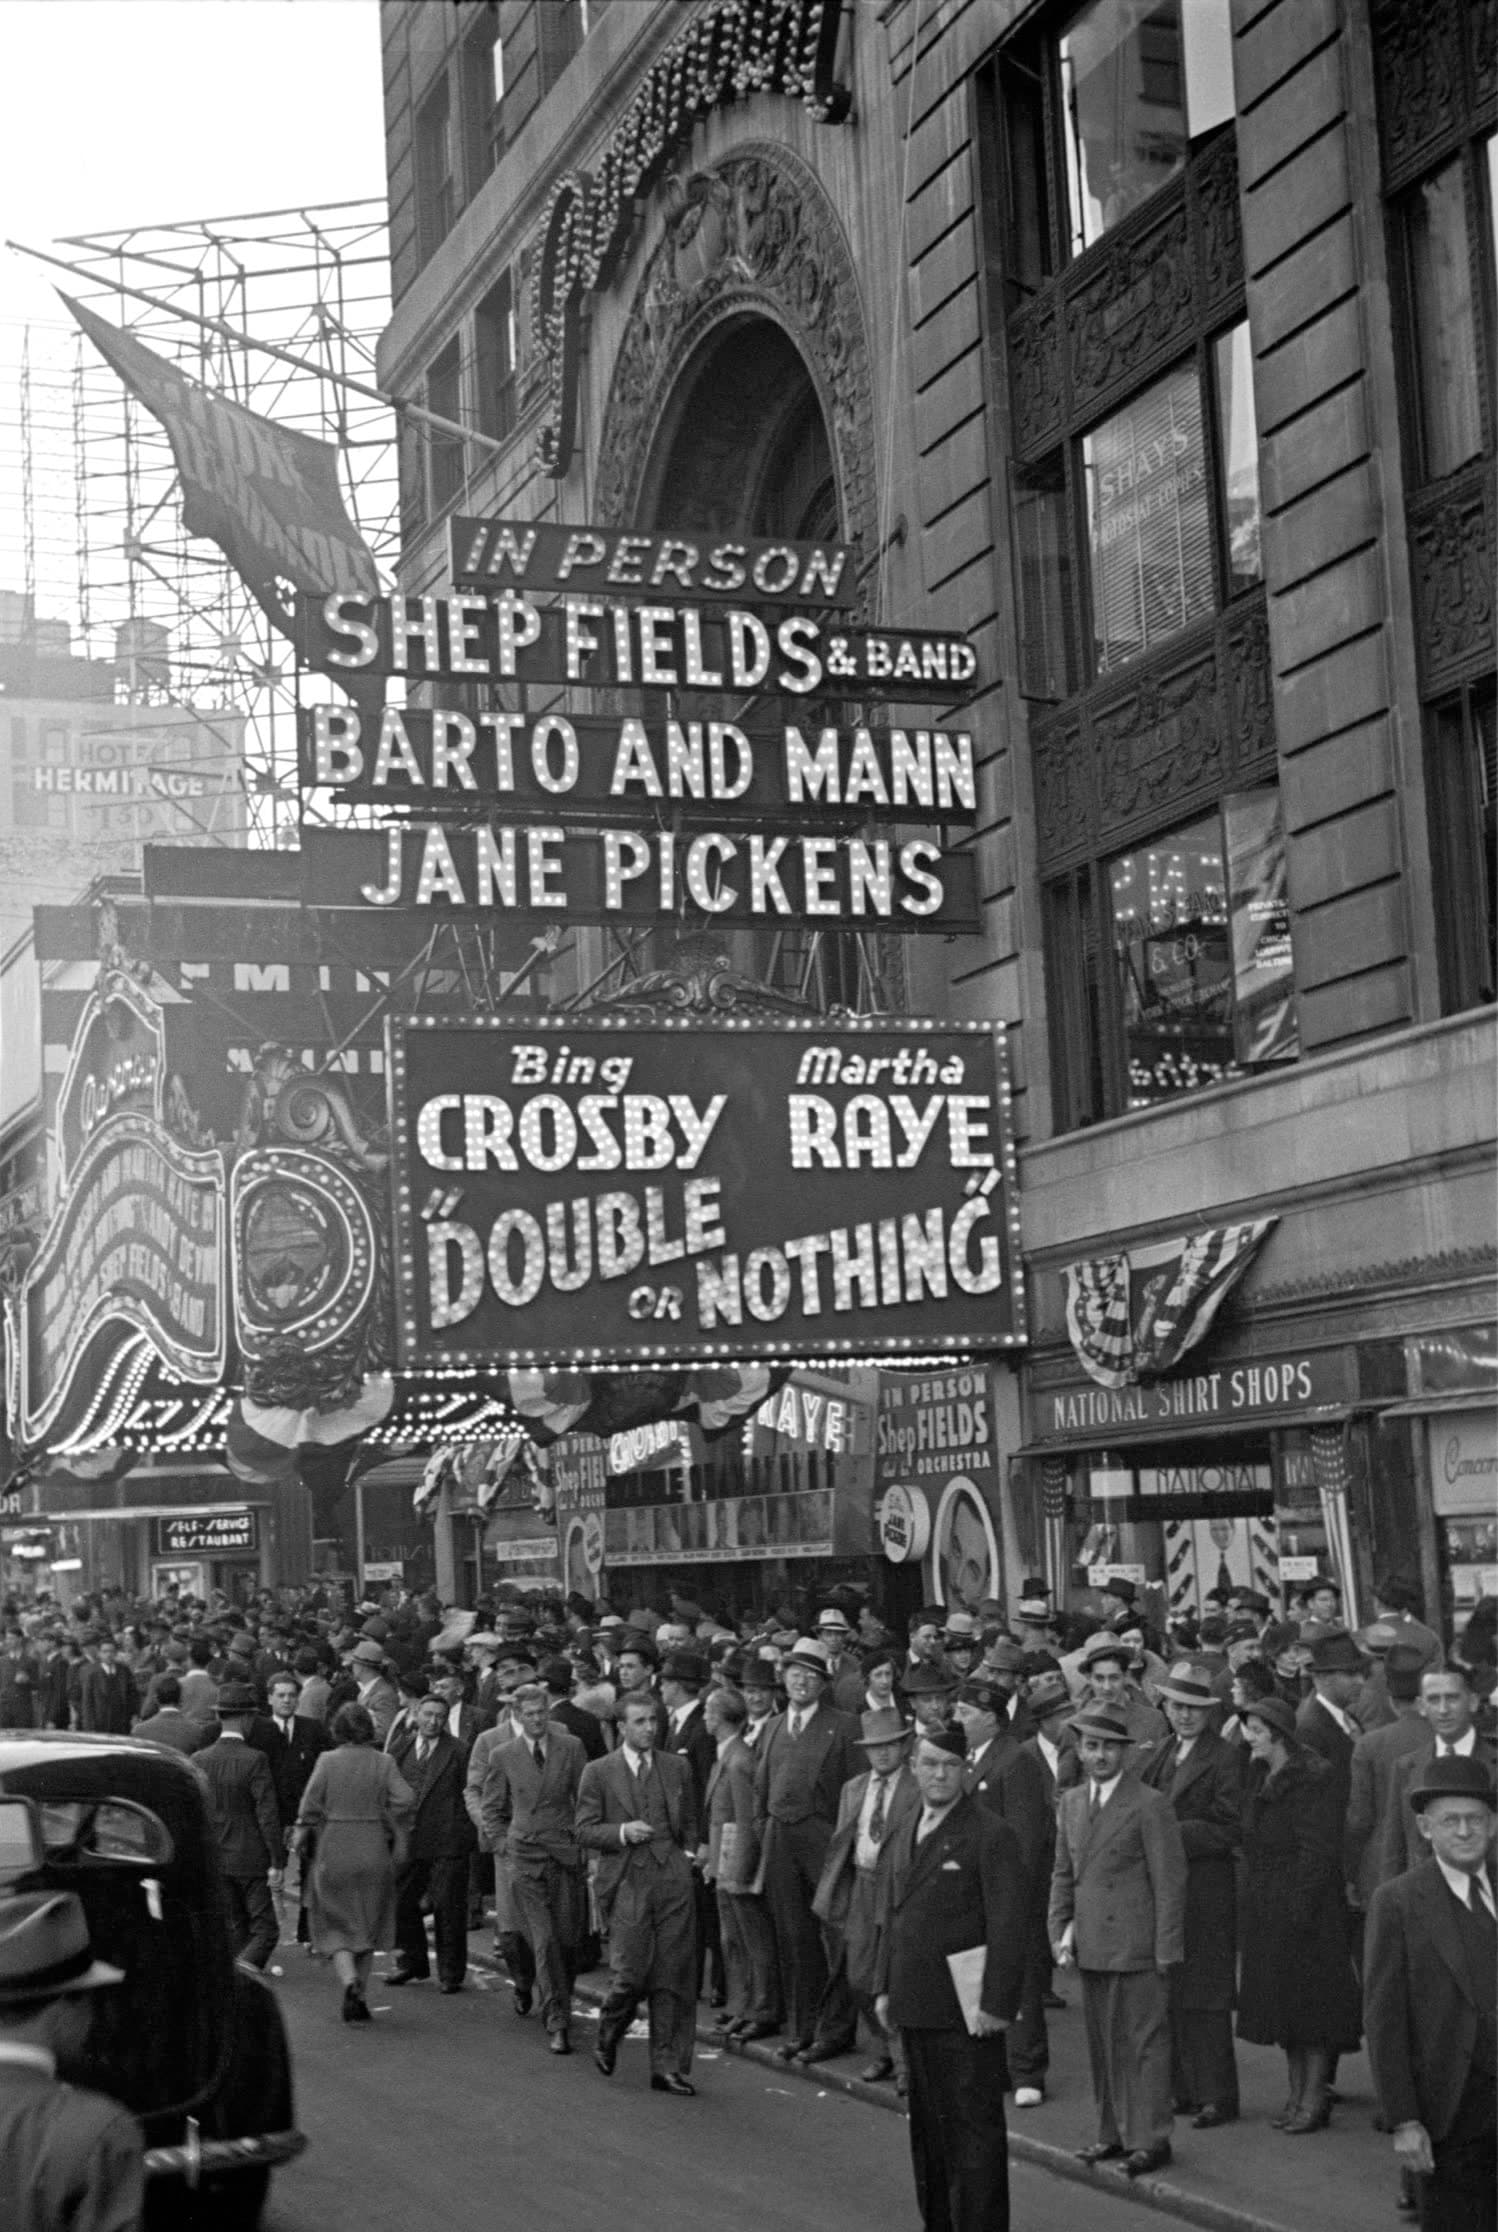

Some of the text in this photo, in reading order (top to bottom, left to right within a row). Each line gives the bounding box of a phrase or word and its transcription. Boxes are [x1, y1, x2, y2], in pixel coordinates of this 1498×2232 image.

[465, 526, 847, 598] IN PERSON
[324, 590, 978, 694] SHEP FIELDS & BAND
[314, 703, 977, 809] BARTO AND MANN
[360, 825, 945, 916] JANE PICKENS
[511, 1045, 633, 1094] Bing
[796, 1046, 966, 1086] Martha
[416, 1094, 728, 1171] CROSBY
[788, 1095, 995, 1168] RAYE
[627, 1286, 683, 1321] OR
[884, 1372, 987, 1409] IN PERSON
[1053, 1361, 1313, 1430] NATIONAL SHIRT SHOPS
[878, 1400, 989, 1468] Shep FIELDS
[917, 1450, 991, 1475] ORCHESTRA
[1155, 1465, 1257, 1494] NATIONAL
